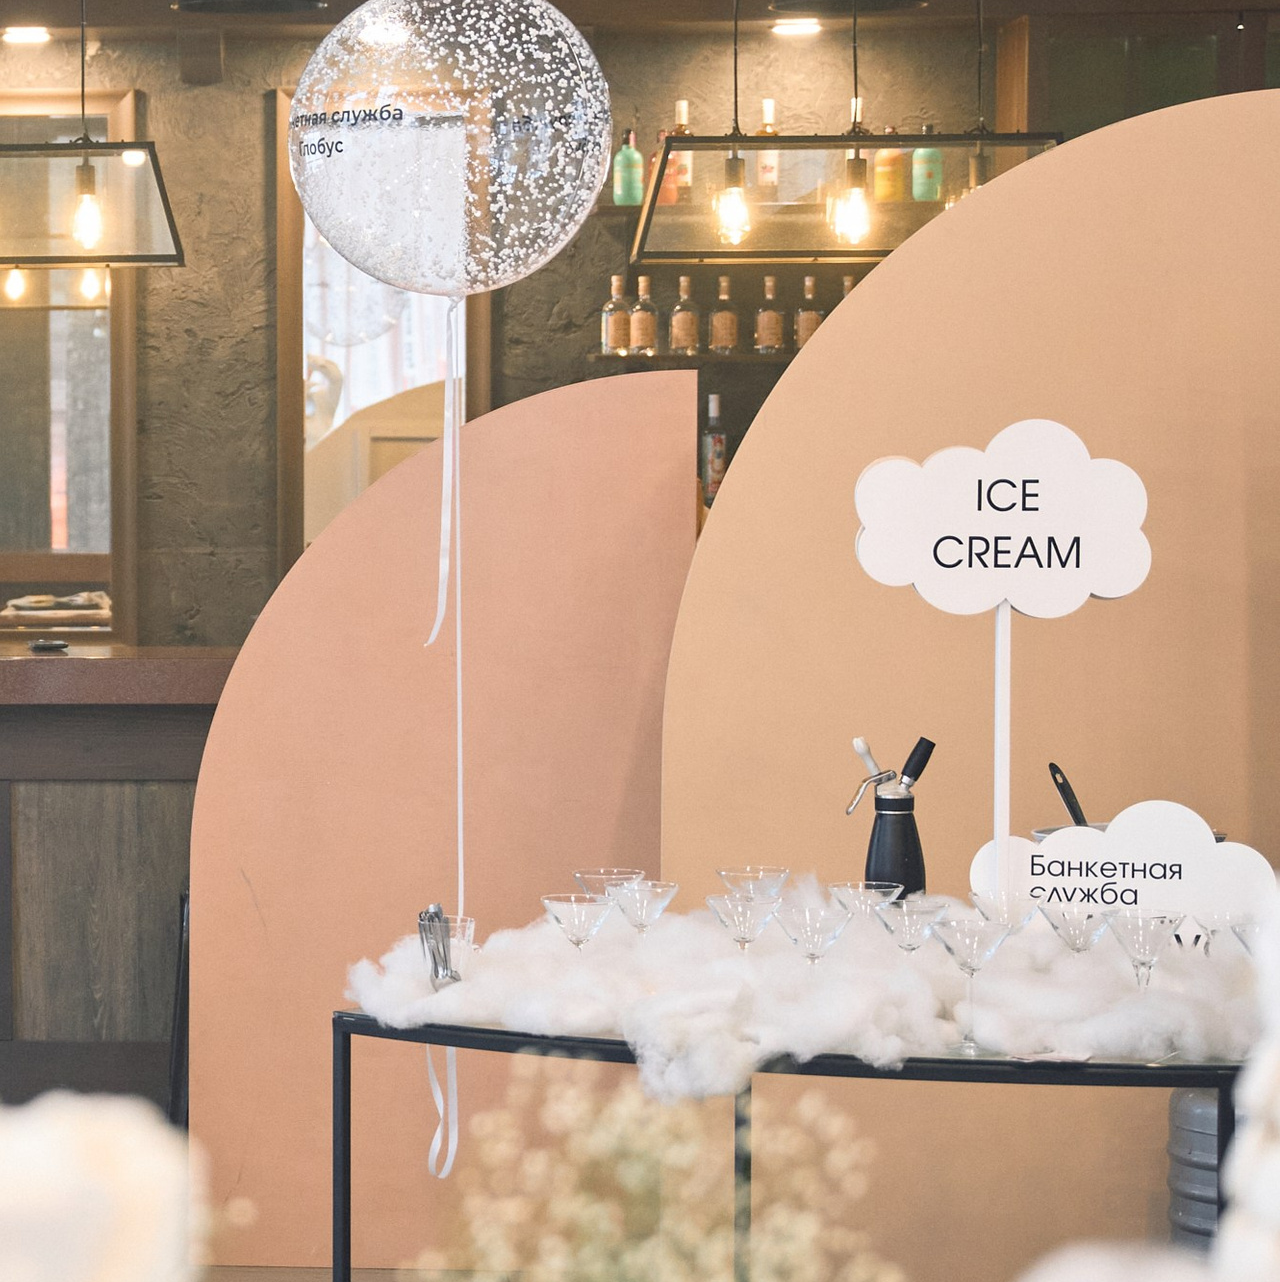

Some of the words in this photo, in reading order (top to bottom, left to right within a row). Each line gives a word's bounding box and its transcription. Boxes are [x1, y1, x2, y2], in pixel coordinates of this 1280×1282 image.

[331, 103, 404, 127] служба
[299, 137, 344, 158] Глобус
[977, 478, 1040, 512] ICE
[932, 535, 1082, 569] CREAM
[1030, 854, 1183, 880] Банкетная
